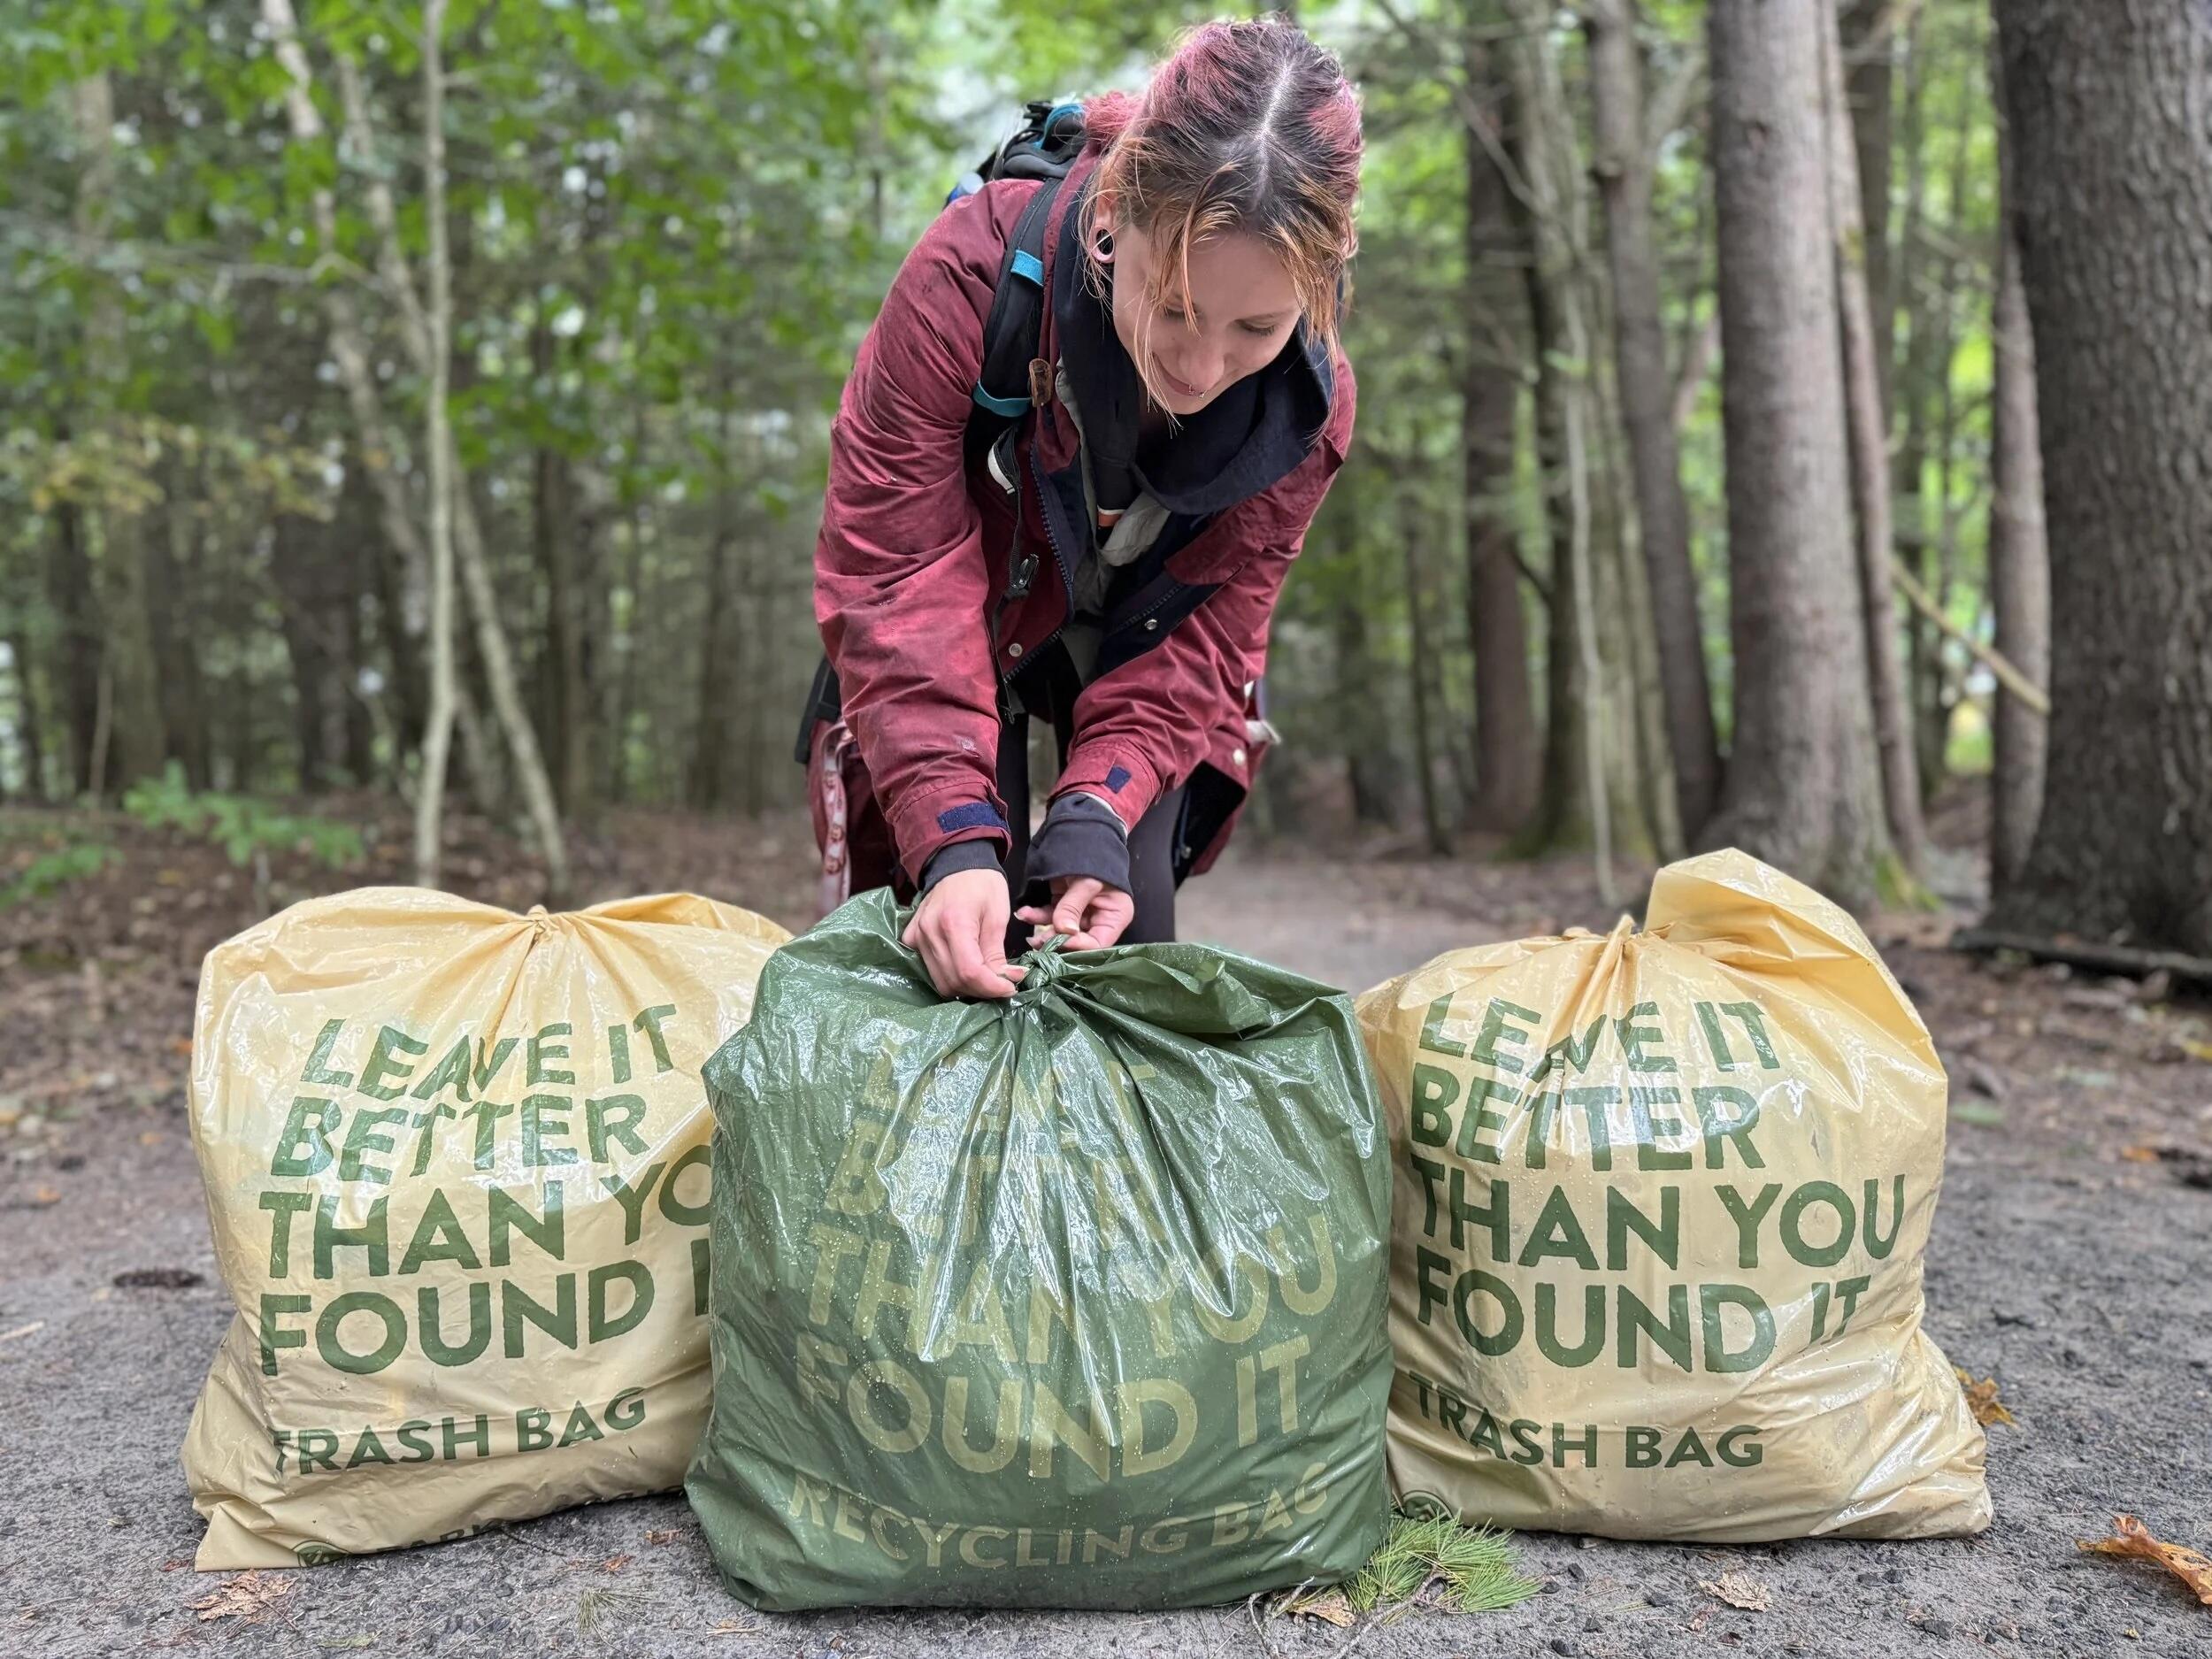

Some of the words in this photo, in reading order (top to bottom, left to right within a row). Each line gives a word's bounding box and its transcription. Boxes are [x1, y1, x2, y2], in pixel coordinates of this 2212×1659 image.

[300, 1018, 575, 1102] LEAVE
[608, 1004, 677, 1085] IT
[1694, 1001, 1781, 1072] IT
[271, 1094, 650, 1186] BETTER
[1411, 1062, 1766, 1171] BETTER
[258, 1179, 565, 1280] THAN
[598, 1144, 713, 1246] YO
[1411, 1153, 1680, 1271] THAN
[1714, 1174, 1906, 1270] YOU
[259, 1259, 655, 1376] FOUND
[1417, 1246, 1772, 1373] FOUND
[1809, 1275, 1870, 1344] IT
[517, 1386, 647, 1454] BAG
[795, 1331, 1199, 1484] FOUND
[1236, 1334, 1310, 1448] IT
[1409, 1370, 1598, 1469] TRASH
[1625, 1425, 1763, 1468] BAG
[788, 1477, 1189, 1569] RECYCLING
